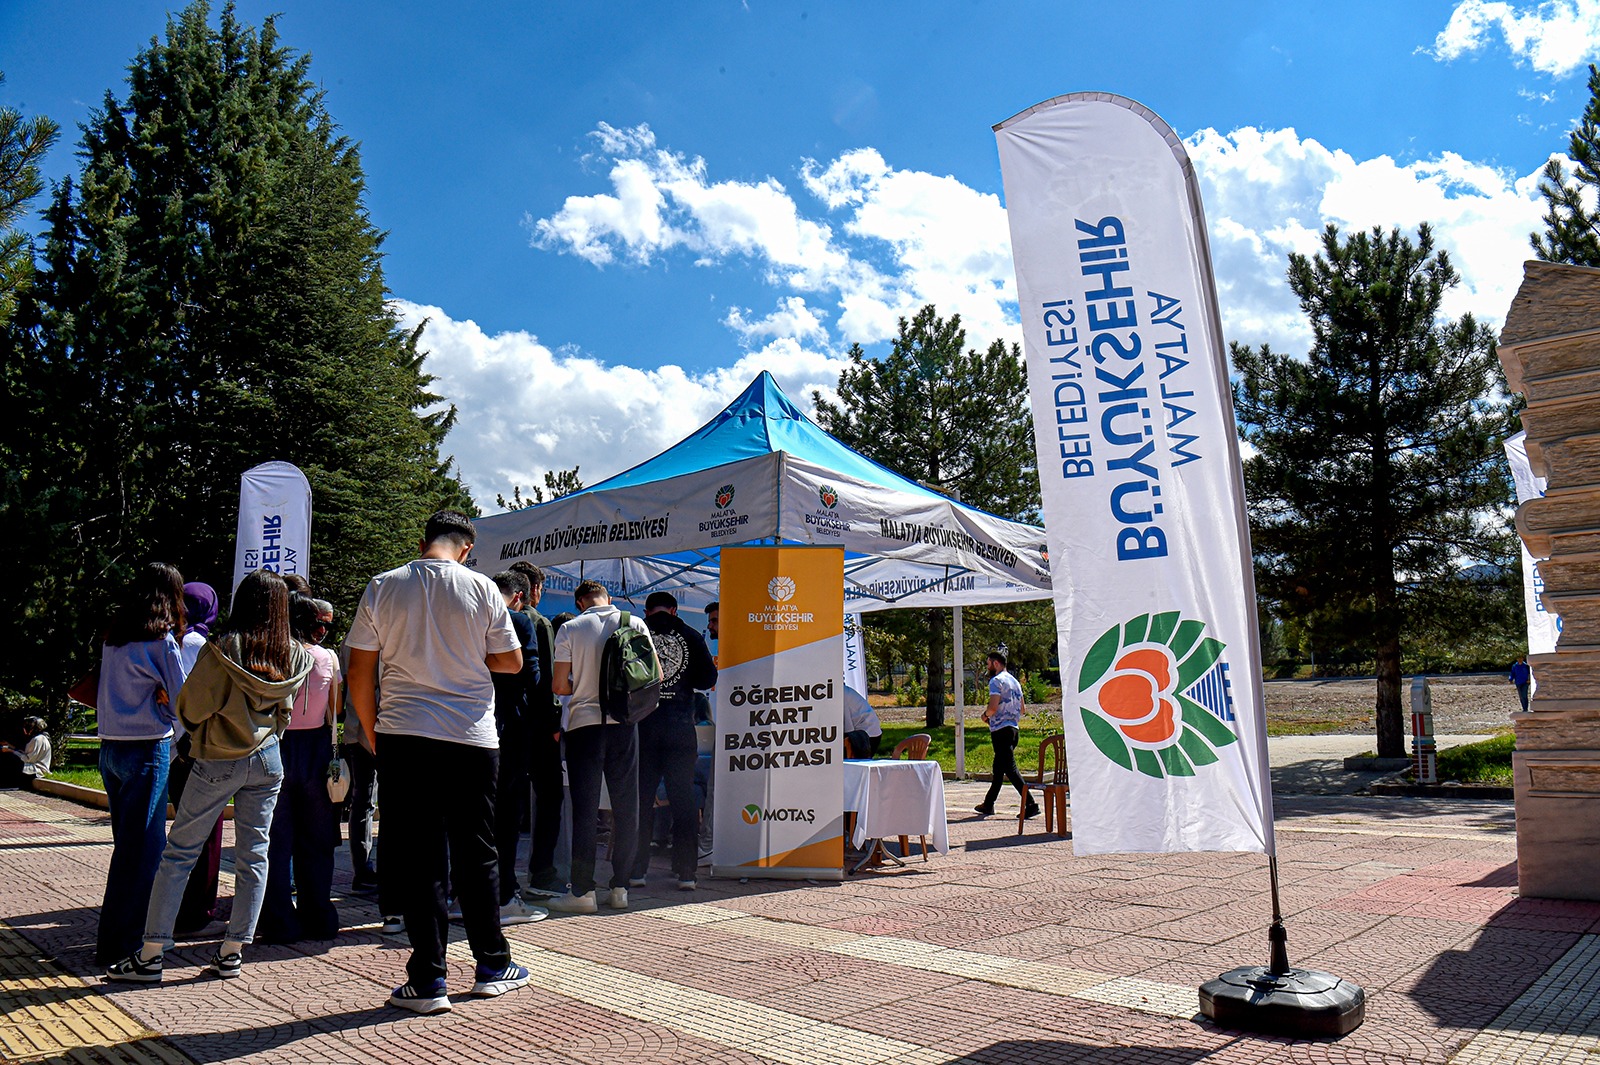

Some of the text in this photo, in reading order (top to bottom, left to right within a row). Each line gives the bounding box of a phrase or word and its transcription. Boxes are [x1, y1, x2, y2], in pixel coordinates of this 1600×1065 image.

[711, 508, 736, 519] MALATYA
[816, 508, 840, 519] MALATYA
[500, 513, 669, 560] MALATYA BÜYÜKŞEHİR BELEDİYESİ
[880, 518, 921, 543] MALATYA
[748, 612, 814, 624] BÜYÜKŞEHİR
[764, 604, 798, 612] MALATYA
[729, 679, 833, 707] ÖĞRENCİ
[750, 706, 813, 727] KART
[724, 726, 837, 751] BAŞVURU
[729, 748, 832, 772] NOKTASI
[763, 808, 815, 824] MOTAŞ
